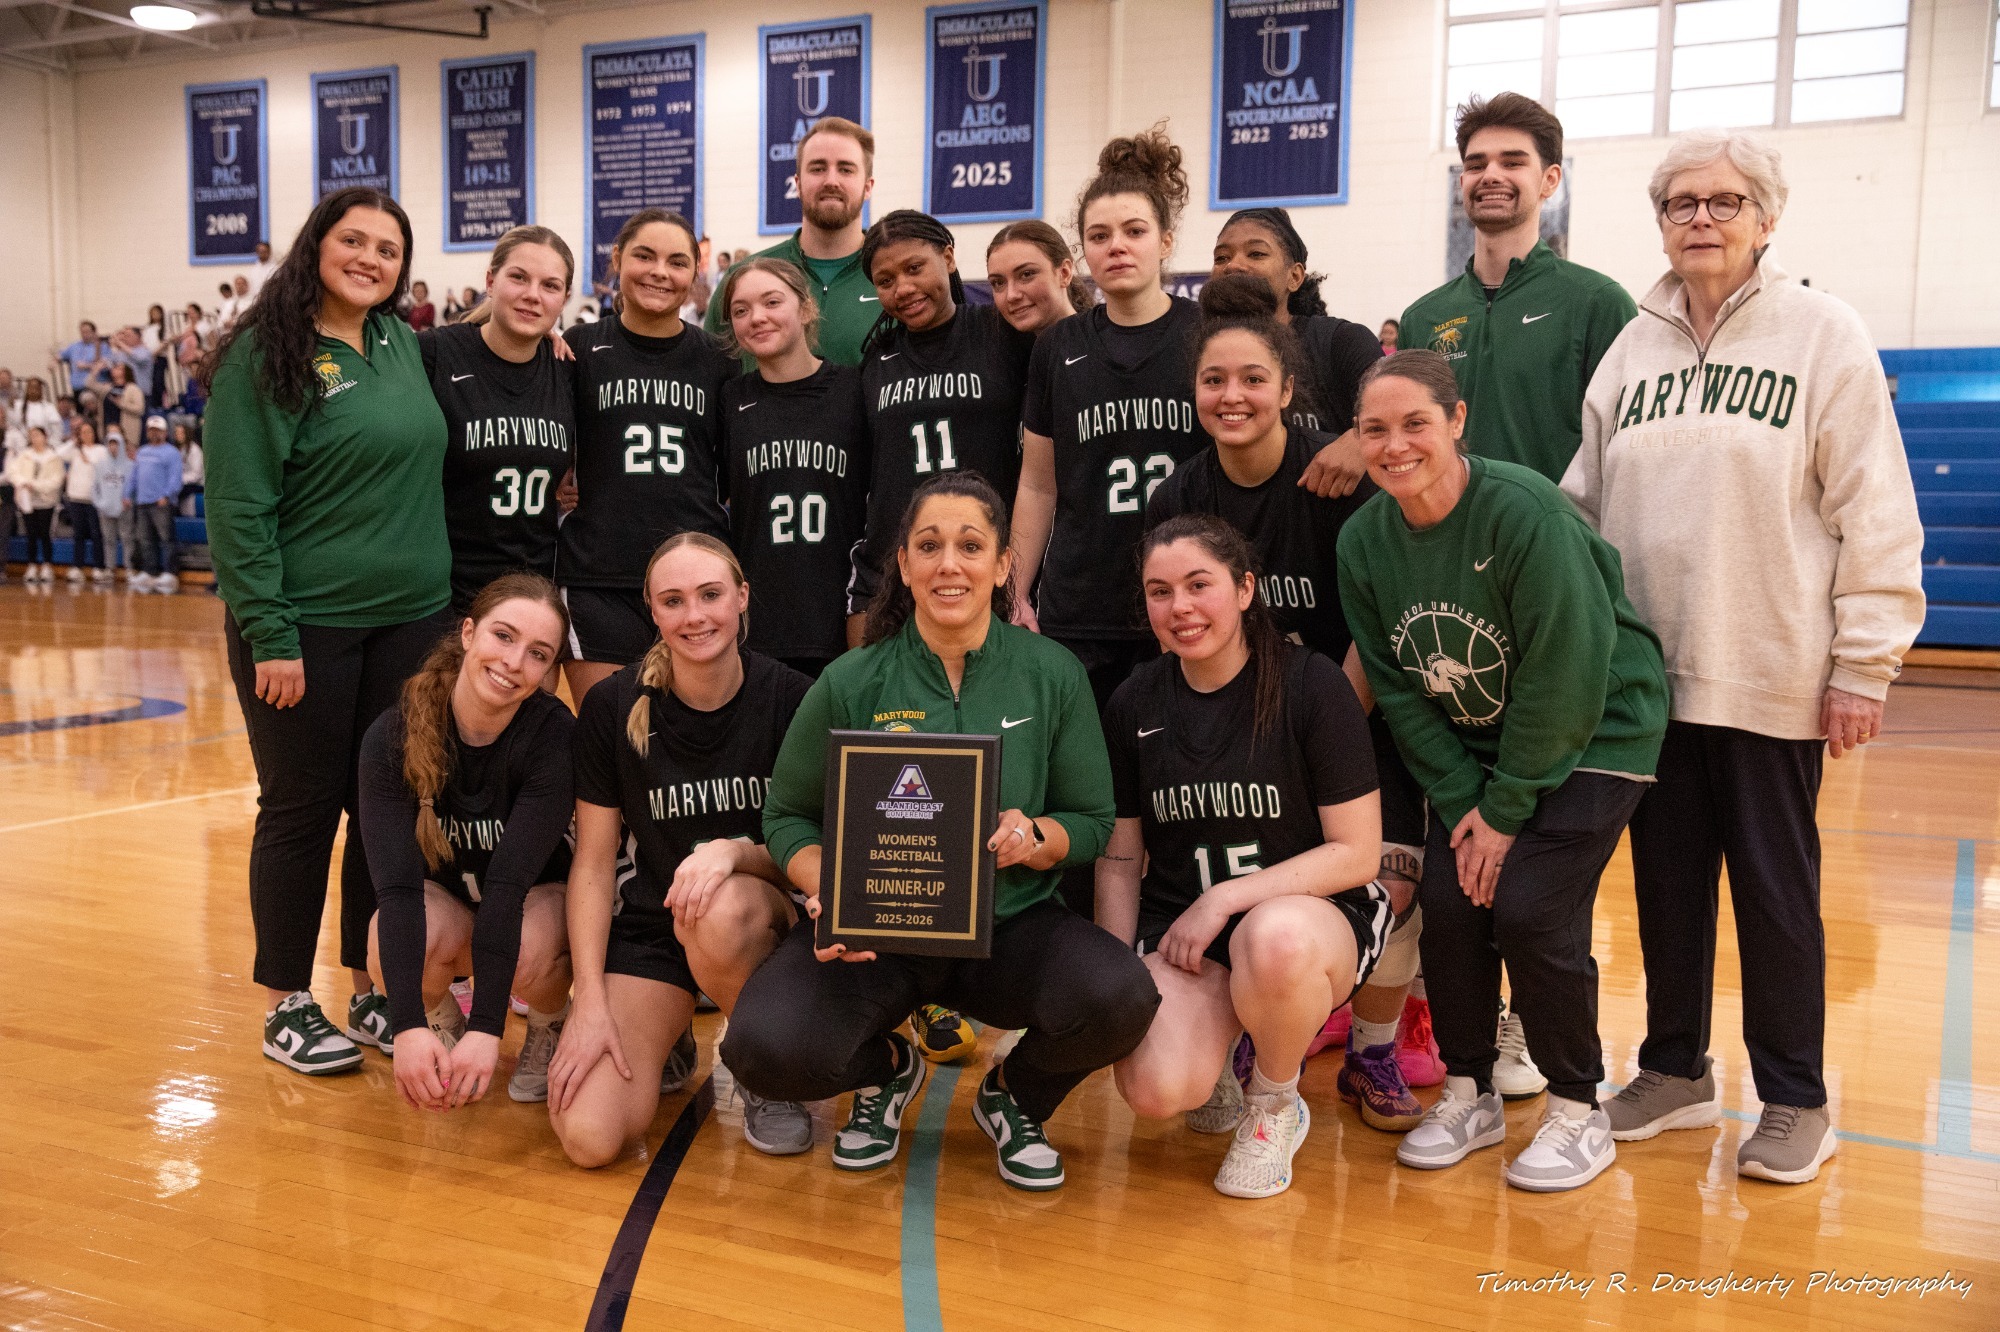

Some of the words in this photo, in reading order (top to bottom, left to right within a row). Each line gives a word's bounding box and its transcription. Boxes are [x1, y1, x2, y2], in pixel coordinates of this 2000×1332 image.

[456, 65, 517, 90] CATHY
[463, 88, 510, 111] RUSH
[1242, 77, 1319, 107] NCAA
[1226, 102, 1337, 127] TOURNAMENT
[935, 124, 1031, 148] CHAMPIONS
[1231, 126, 1270, 144] 2022
[1288, 122, 1328, 140] 2025
[330, 155, 377, 178] NCAA
[951, 160, 1012, 188] 2025
[321, 379, 358, 398] ASKETBALL
[599, 379, 704, 416] MARYWOOD
[878, 372, 982, 411] MARYWOOD
[466, 417, 567, 452] MARYWOOD
[1078, 398, 1191, 443] MARYWOOD
[624, 424, 685, 474] 25
[747, 440, 846, 478] MARYWOOD
[911, 420, 957, 473] 11
[491, 467, 551, 516] 30
[1108, 454, 1175, 513] 22
[770, 494, 827, 543] 20
[1391, 602, 1423, 652] ARYWOOD
[873, 710, 926, 722] MARYWOOD
[876, 801, 919, 811] ATLANTIC
[919, 802, 944, 812] EAST
[885, 811, 934, 819] CONFERENCE
[1152, 782, 1281, 823] MARYWOOD
[877, 833, 937, 846] WOMEN'S
[869, 849, 944, 862] BASKETBALL
[1194, 843, 1263, 894] 15
[866, 878, 945, 896] RUNNER-UP
[875, 913, 934, 925] 2025-2026
